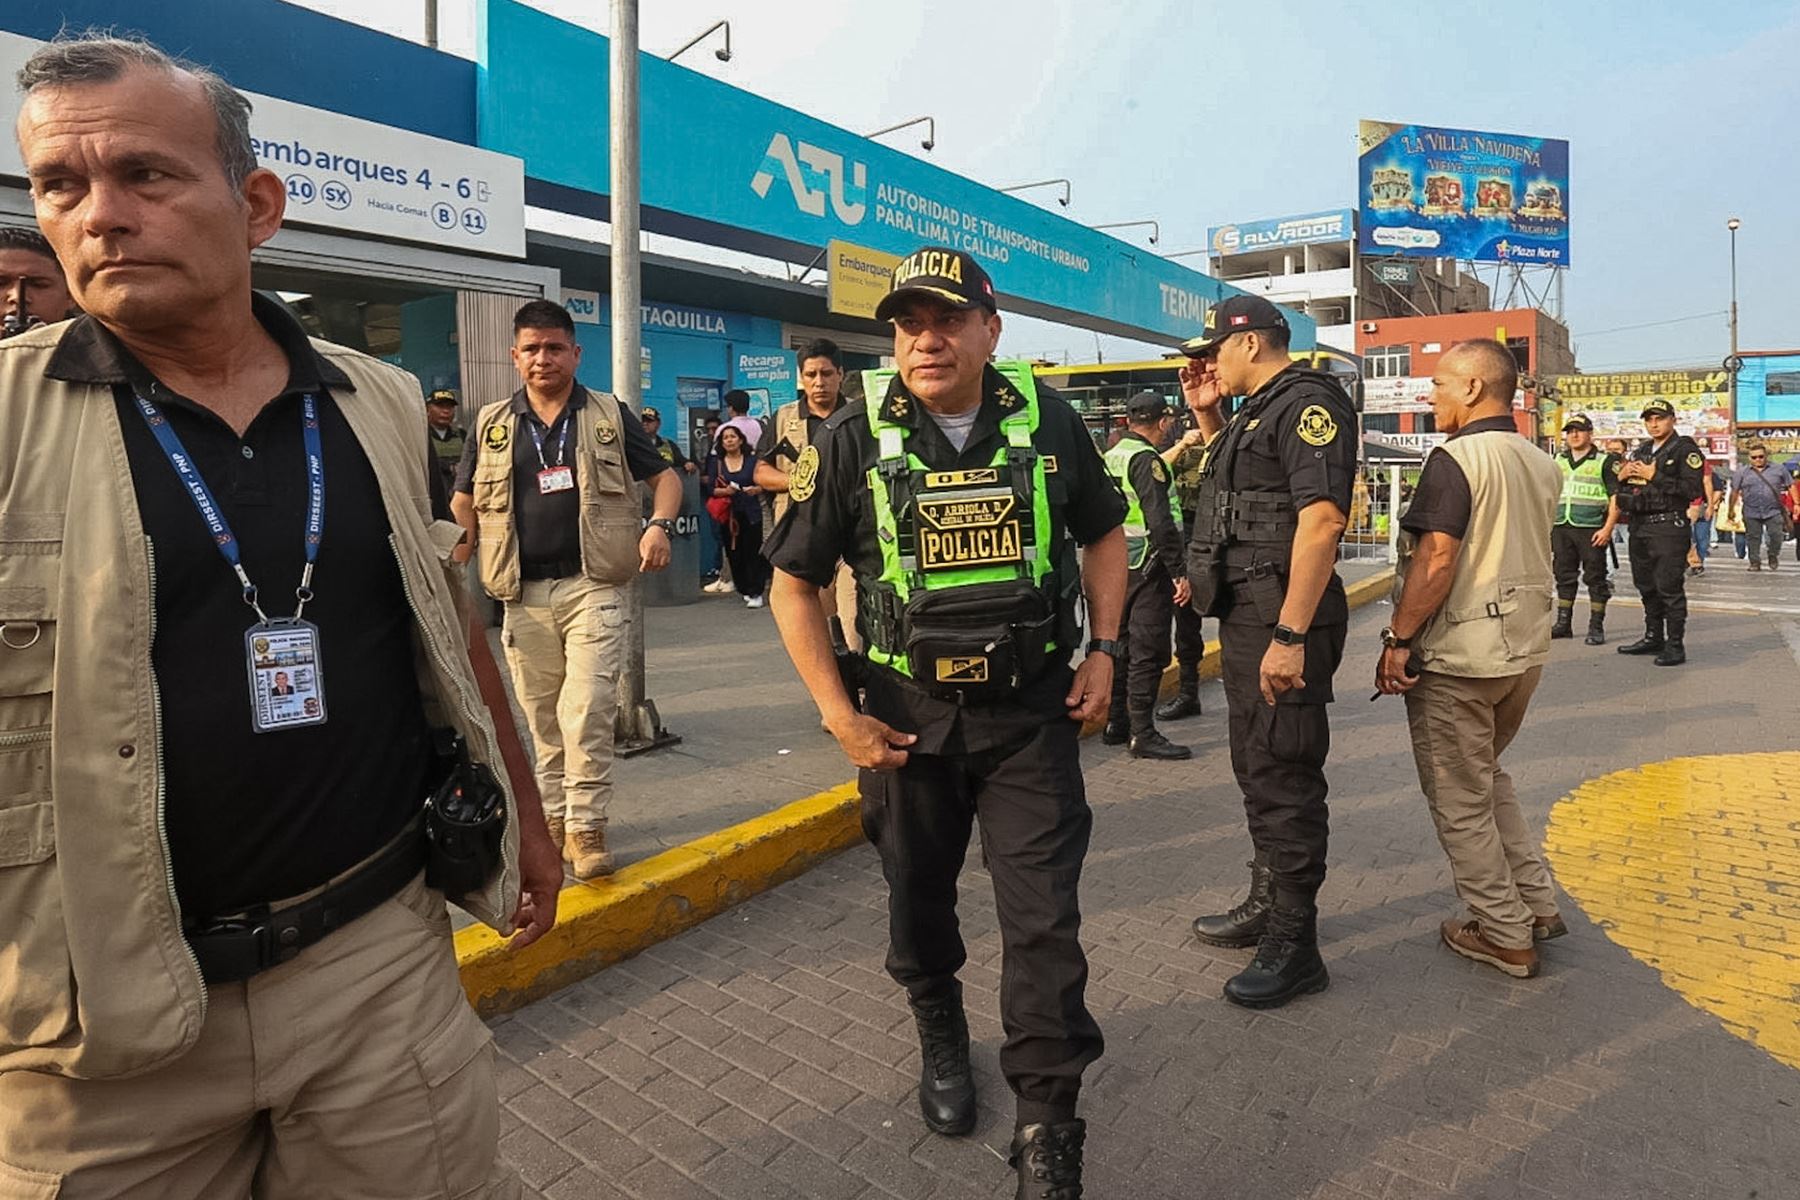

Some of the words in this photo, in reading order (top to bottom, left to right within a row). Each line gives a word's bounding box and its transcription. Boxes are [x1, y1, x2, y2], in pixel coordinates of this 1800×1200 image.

[1425, 133, 1469, 151] VILLA
[416, 168, 432, 190] 4
[457, 177, 471, 199] 6
[750, 132, 867, 226] ATU
[288, 180, 313, 199] 10
[326, 187, 347, 204] SX
[367, 198, 394, 212] Hacia
[396, 203, 427, 217] Comas
[439, 208, 449, 223] B
[465, 213, 483, 229] 11
[876, 183, 959, 225] AUTORIDAD
[962, 212, 978, 231] DE
[980, 219, 1049, 259] TRANSPORTE
[1051, 246, 1090, 272] URBANO
[876, 205, 915, 232] PARA
[918, 217, 950, 244] LIMA
[952, 230, 962, 247] Y
[963, 232, 1009, 263] CALLAO
[1223, 221, 1343, 247] SALVADOR
[1512, 245, 1535, 257] Plaza
[1537, 247, 1560, 258] Norte
[840, 254, 892, 279] Embarques
[894, 250, 962, 291] POLICIA
[640, 305, 726, 333] TAQUILLA
[739, 354, 784, 368] Recarga
[1630, 382, 1655, 396] DE
[1661, 380, 1706, 394] ORO
[172, 453, 192, 474] PNP
[311, 455, 321, 475] PNP
[188, 480, 224, 533] DIRSEEST
[310, 482, 322, 532] DIRSEEST
[944, 502, 989, 517] ARRIOLA
[927, 526, 1016, 563] POLICIA
